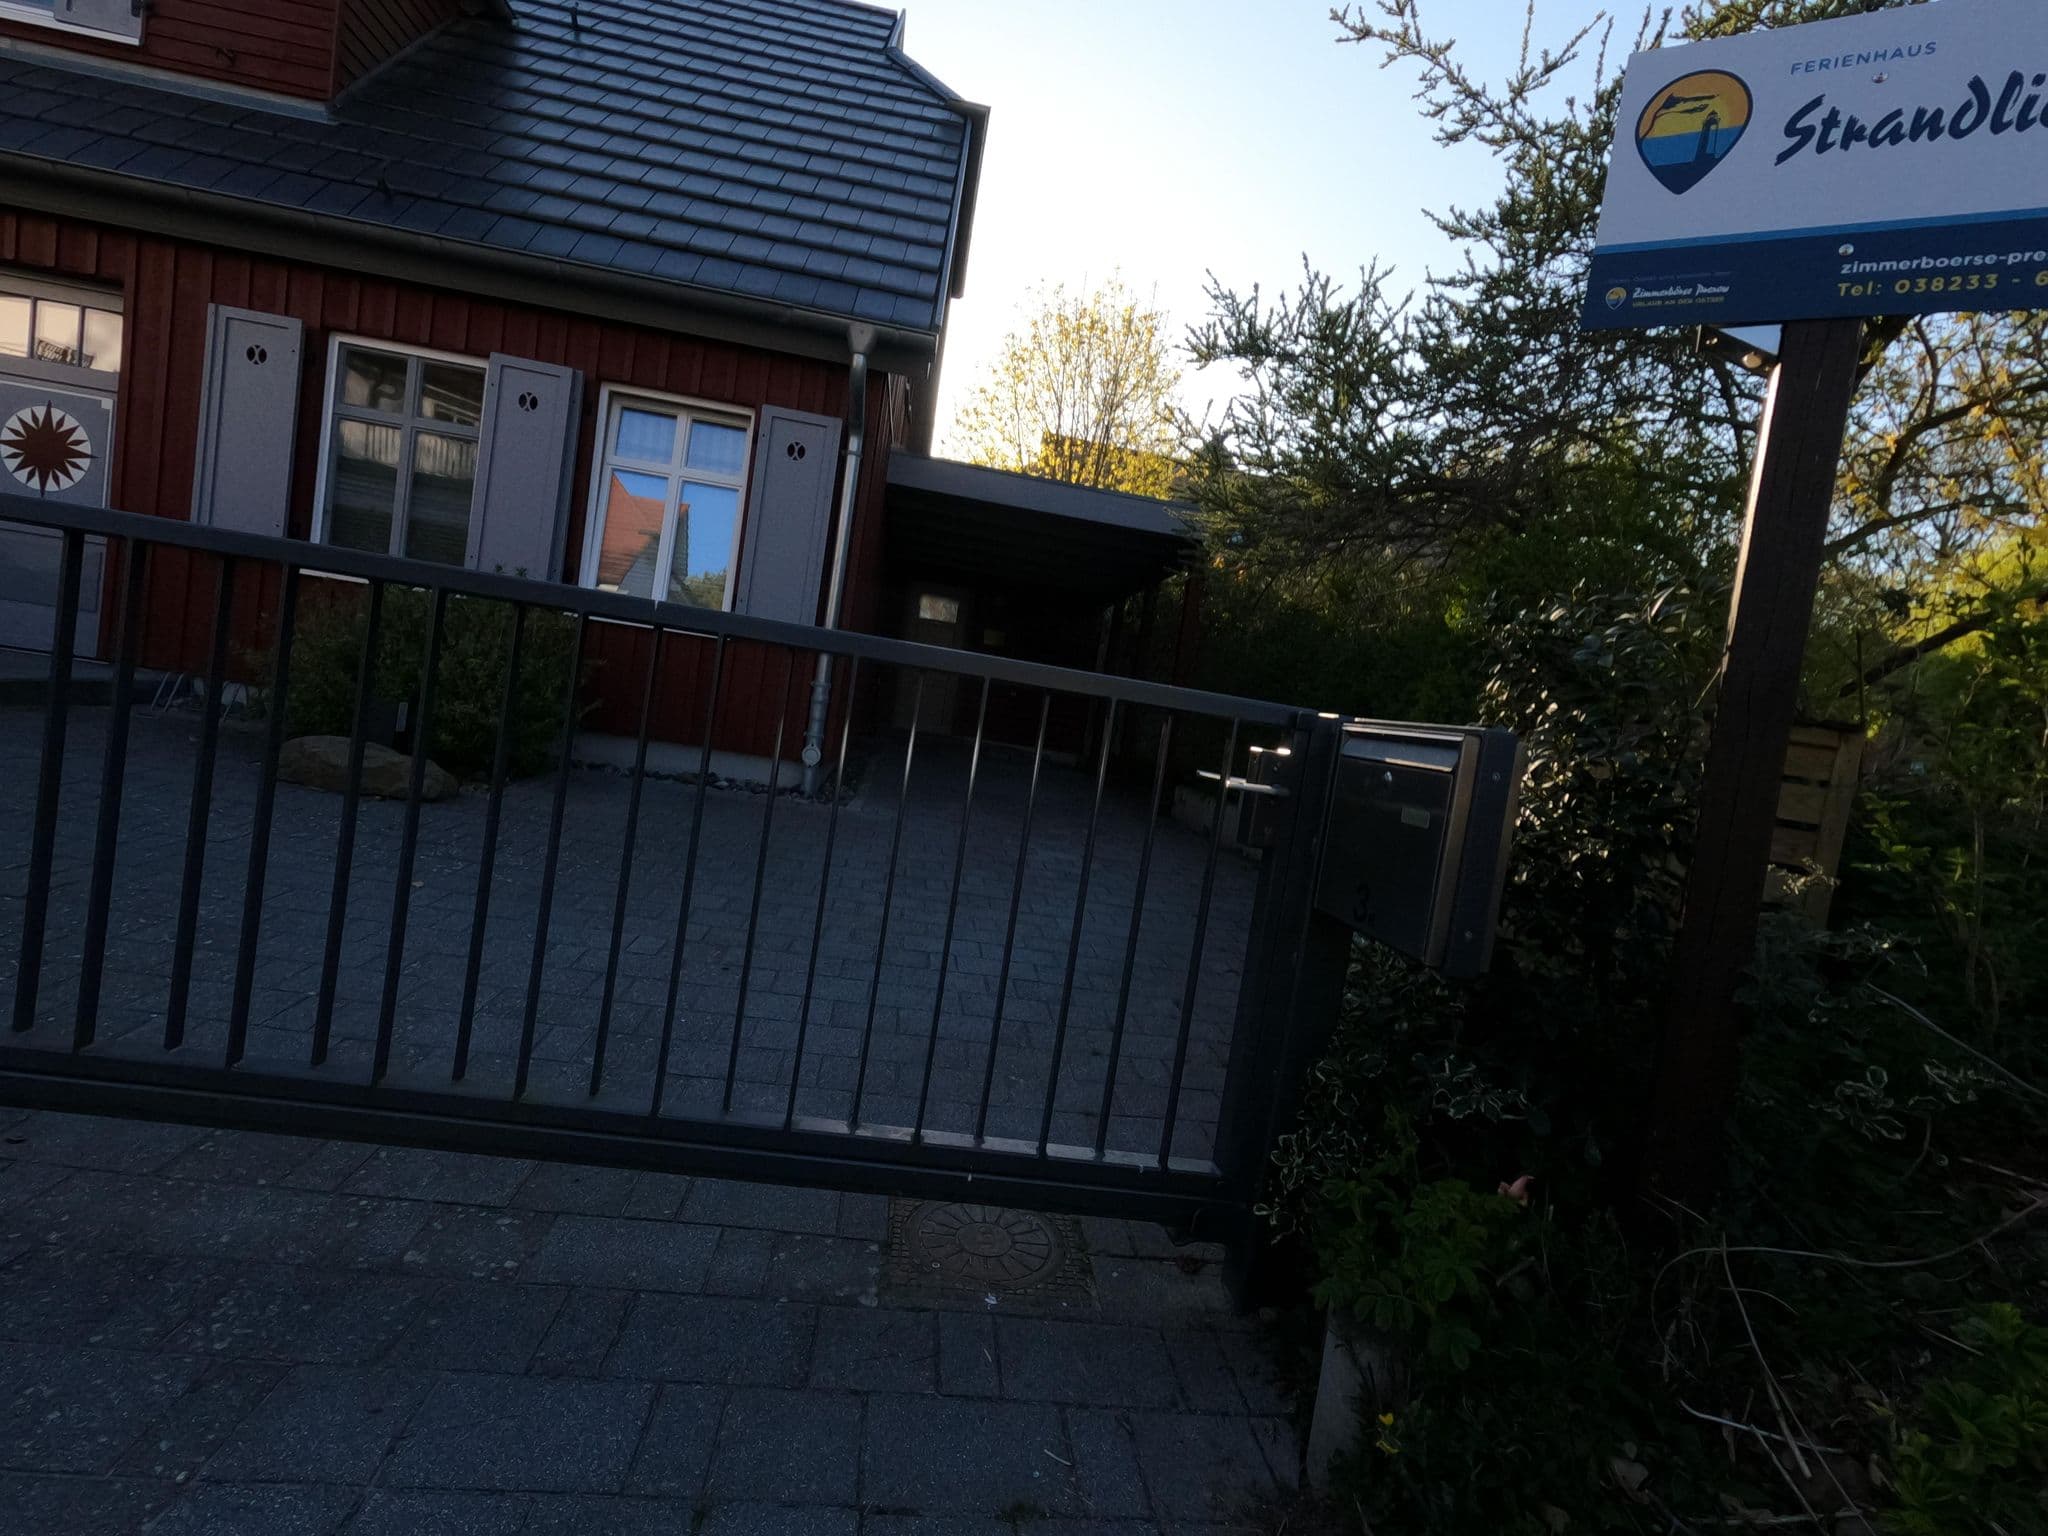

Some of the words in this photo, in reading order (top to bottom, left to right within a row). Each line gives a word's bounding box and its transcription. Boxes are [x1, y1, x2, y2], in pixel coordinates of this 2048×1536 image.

[1790, 41, 1937, 75] FERIENHAUS
[1837, 280, 1882, 297] Tel:
[1894, 273, 1999, 294] 038233
